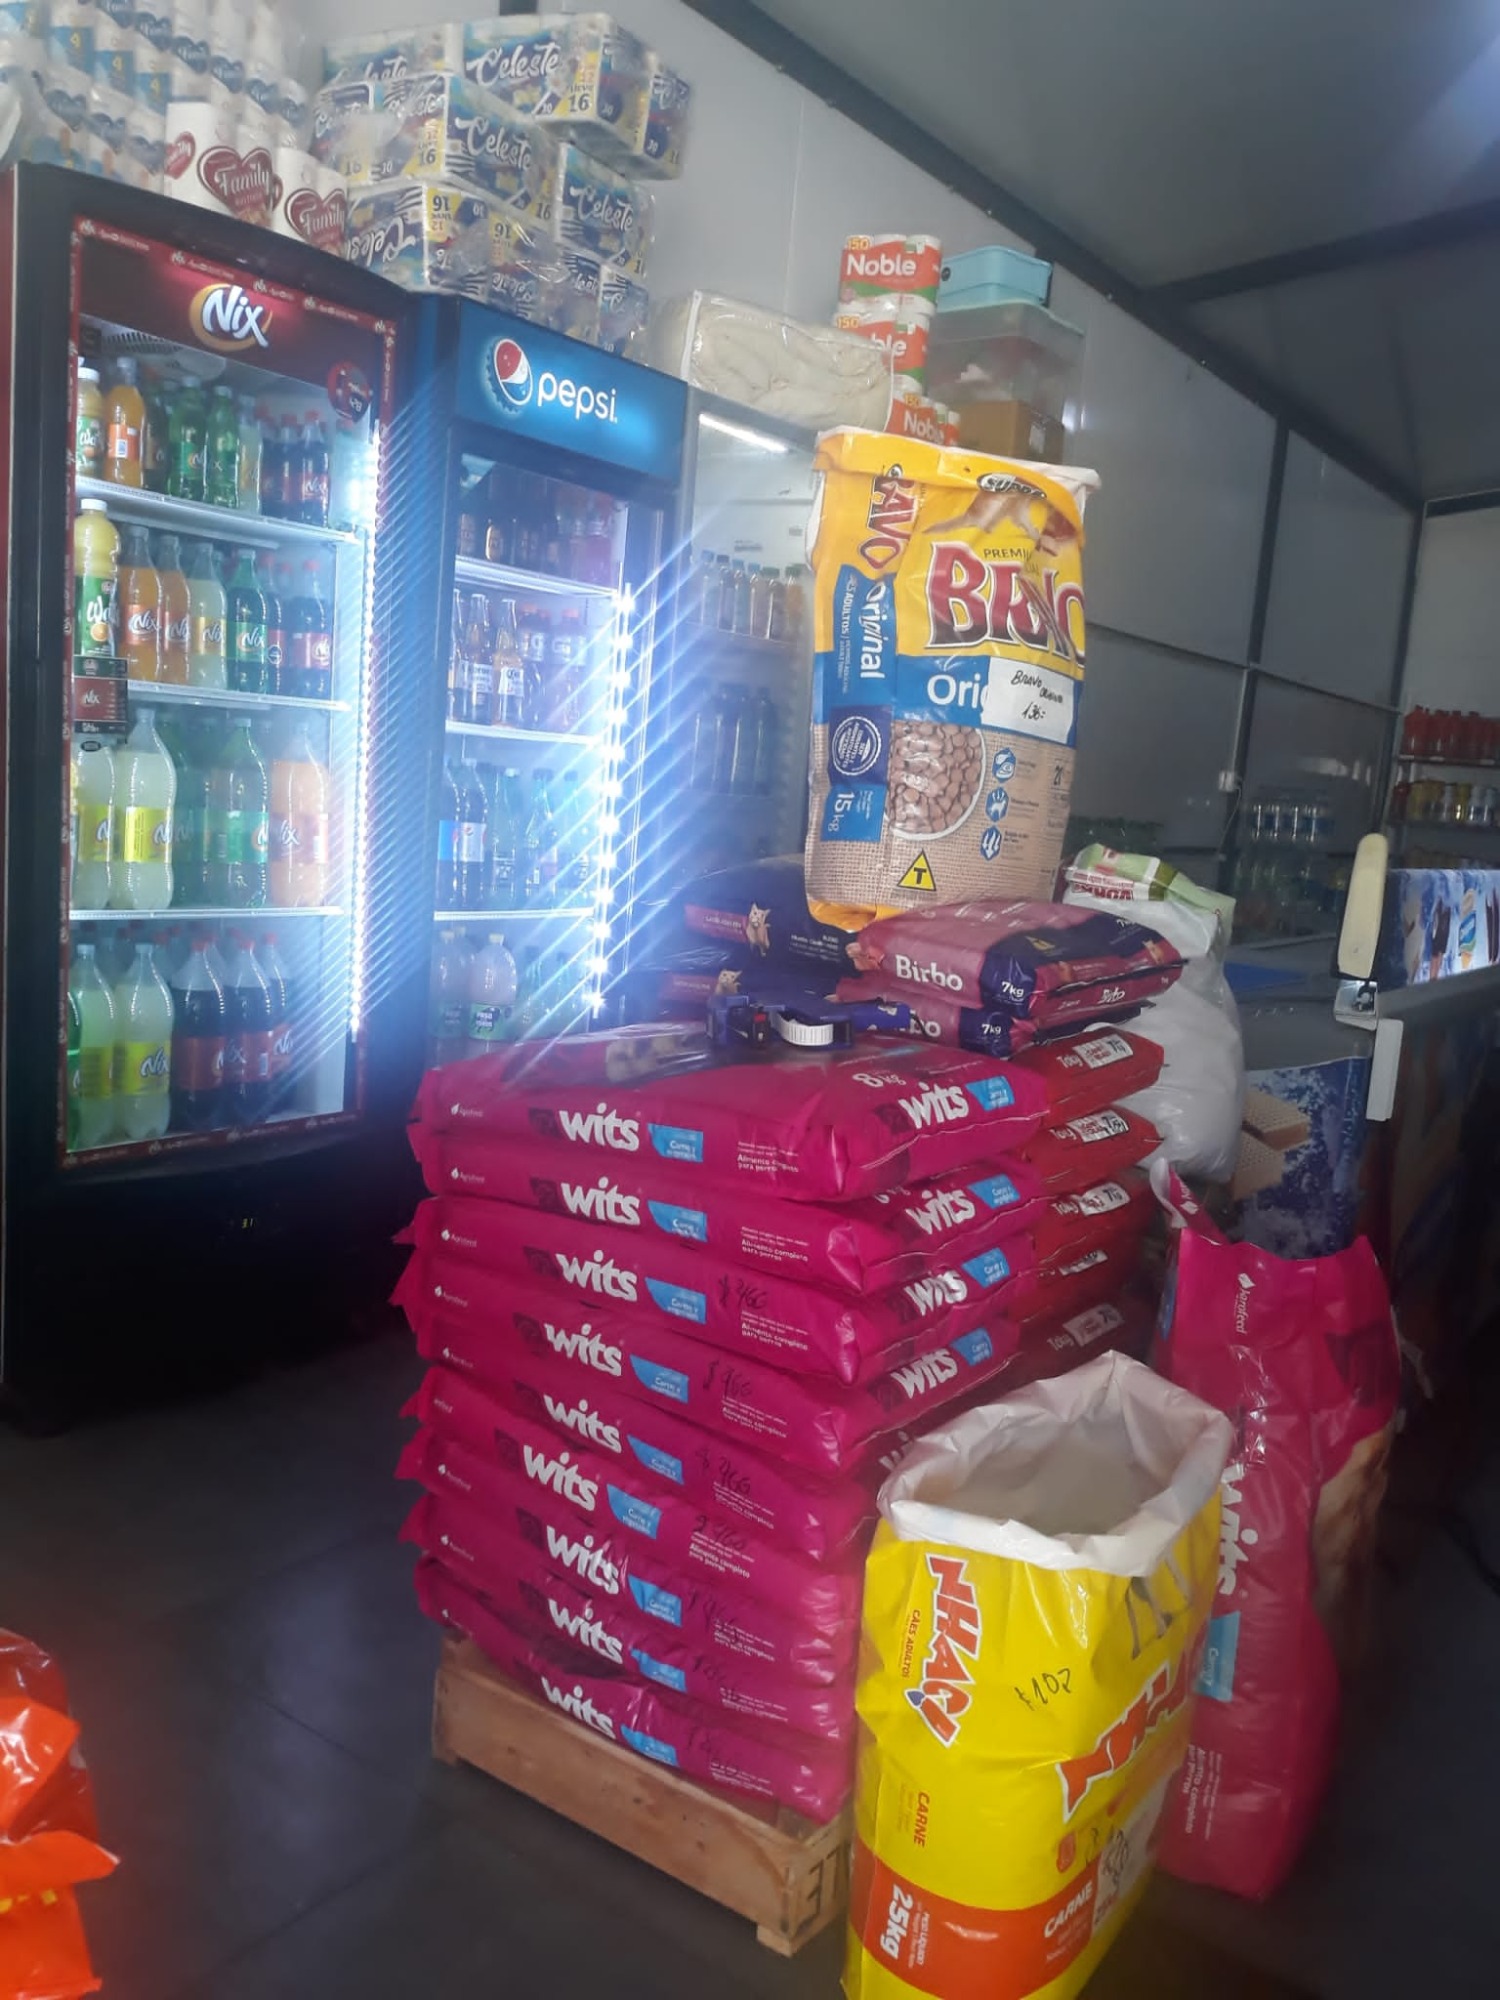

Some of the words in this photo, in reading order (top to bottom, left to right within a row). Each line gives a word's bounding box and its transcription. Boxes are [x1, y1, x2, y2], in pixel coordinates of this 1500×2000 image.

[466, 42, 561, 86] Celeste
[568, 93, 590, 112] 16
[419, 148, 436, 165] 16
[455, 116, 531, 169] Celeste
[214, 160, 270, 196] Family
[299, 202, 345, 236] Family
[434, 195, 449, 211] 16
[570, 187, 634, 231] Celeste
[846, 253, 917, 277] Noble
[202, 285, 269, 348] Nix
[870, 334, 907, 356] ble
[537, 372, 617, 423] pepsi
[129, 609, 158, 637] Nix
[841, 593, 854, 634] ADULTOS
[858, 581, 887, 680] Original
[927, 673, 990, 708] Ori
[914, 867, 927, 885] T
[895, 954, 963, 991] Birbo
[1001, 981, 1024, 998] 7kg
[981, 1023, 1001, 1035] 7kg
[559, 1102, 640, 1152] wits
[898, 1081, 970, 1130] wits
[561, 1176, 640, 1225] wits
[905, 1188, 976, 1236] wits
[556, 1249, 637, 1301] wits
[544, 1323, 622, 1377] wits
[890, 1349, 958, 1399] wits
[543, 1394, 622, 1454] wits
[523, 1444, 598, 1511] wits
[546, 1526, 619, 1594] wits
[548, 1599, 623, 1665] wits
[541, 1677, 616, 1740] wits
[912, 1791, 930, 1848] CARNE
[881, 1884, 914, 1960] 25kg
[1044, 1880, 1093, 1938] CARNE
